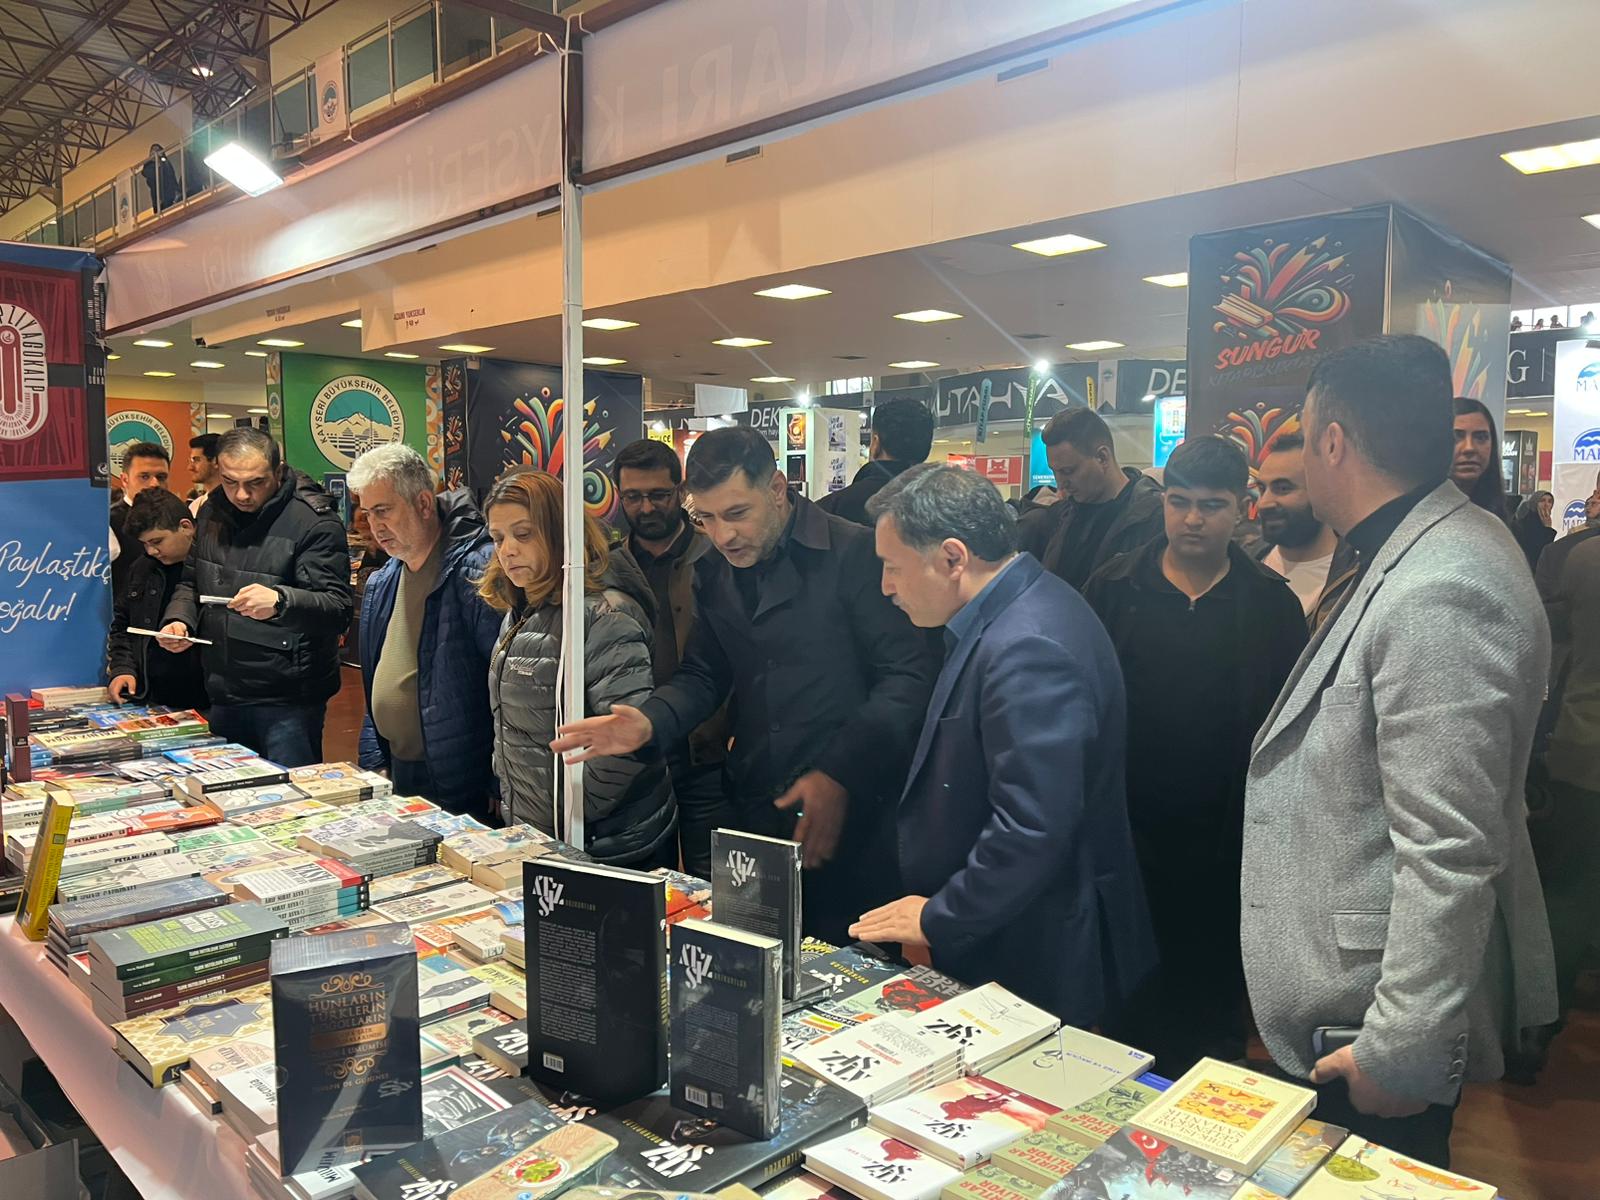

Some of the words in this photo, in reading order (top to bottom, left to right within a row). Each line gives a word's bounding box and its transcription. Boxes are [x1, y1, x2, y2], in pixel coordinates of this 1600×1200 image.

[1214, 328, 1321, 370] SUNGUR
[314, 400, 327, 445] KAYSERİ
[323, 379, 383, 401] BÜYÜKŞEHİR
[74, 835, 98, 844] PEYAMİ
[98, 832, 113, 840] SAFA
[114, 854, 140, 864] PEYAMİ
[141, 851, 158, 859] SAFA
